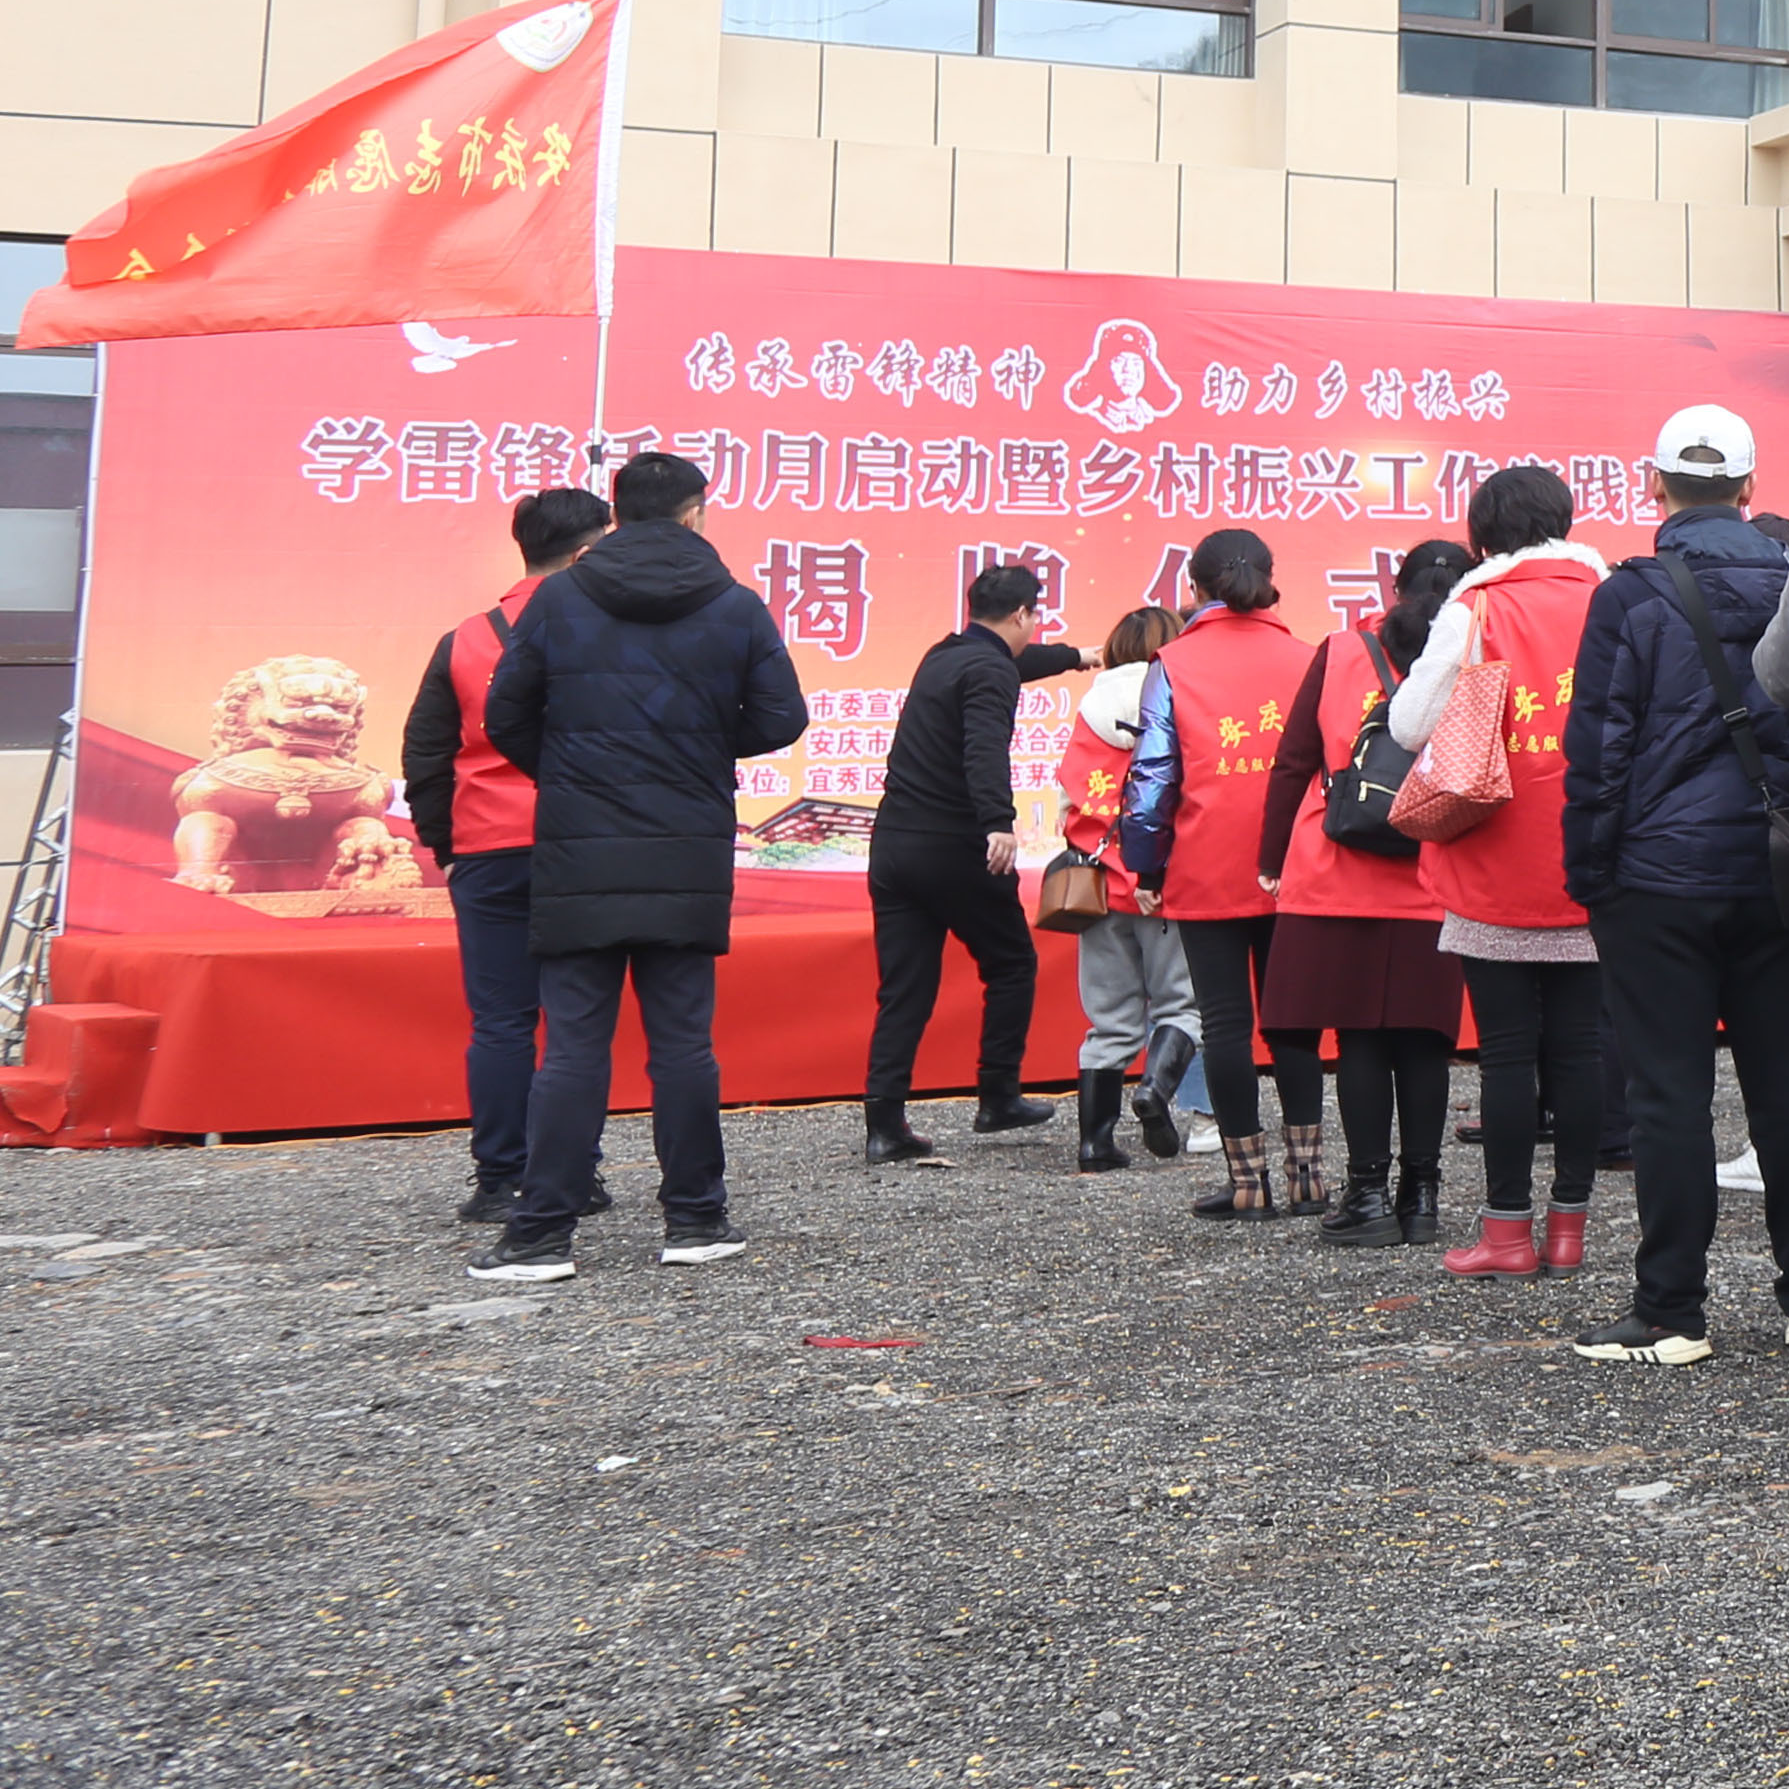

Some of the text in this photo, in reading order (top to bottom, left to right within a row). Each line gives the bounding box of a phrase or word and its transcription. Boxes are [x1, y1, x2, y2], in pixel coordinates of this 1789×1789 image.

[685, 331, 1509, 421] 传承雷锋精神 助力乡村振兴
